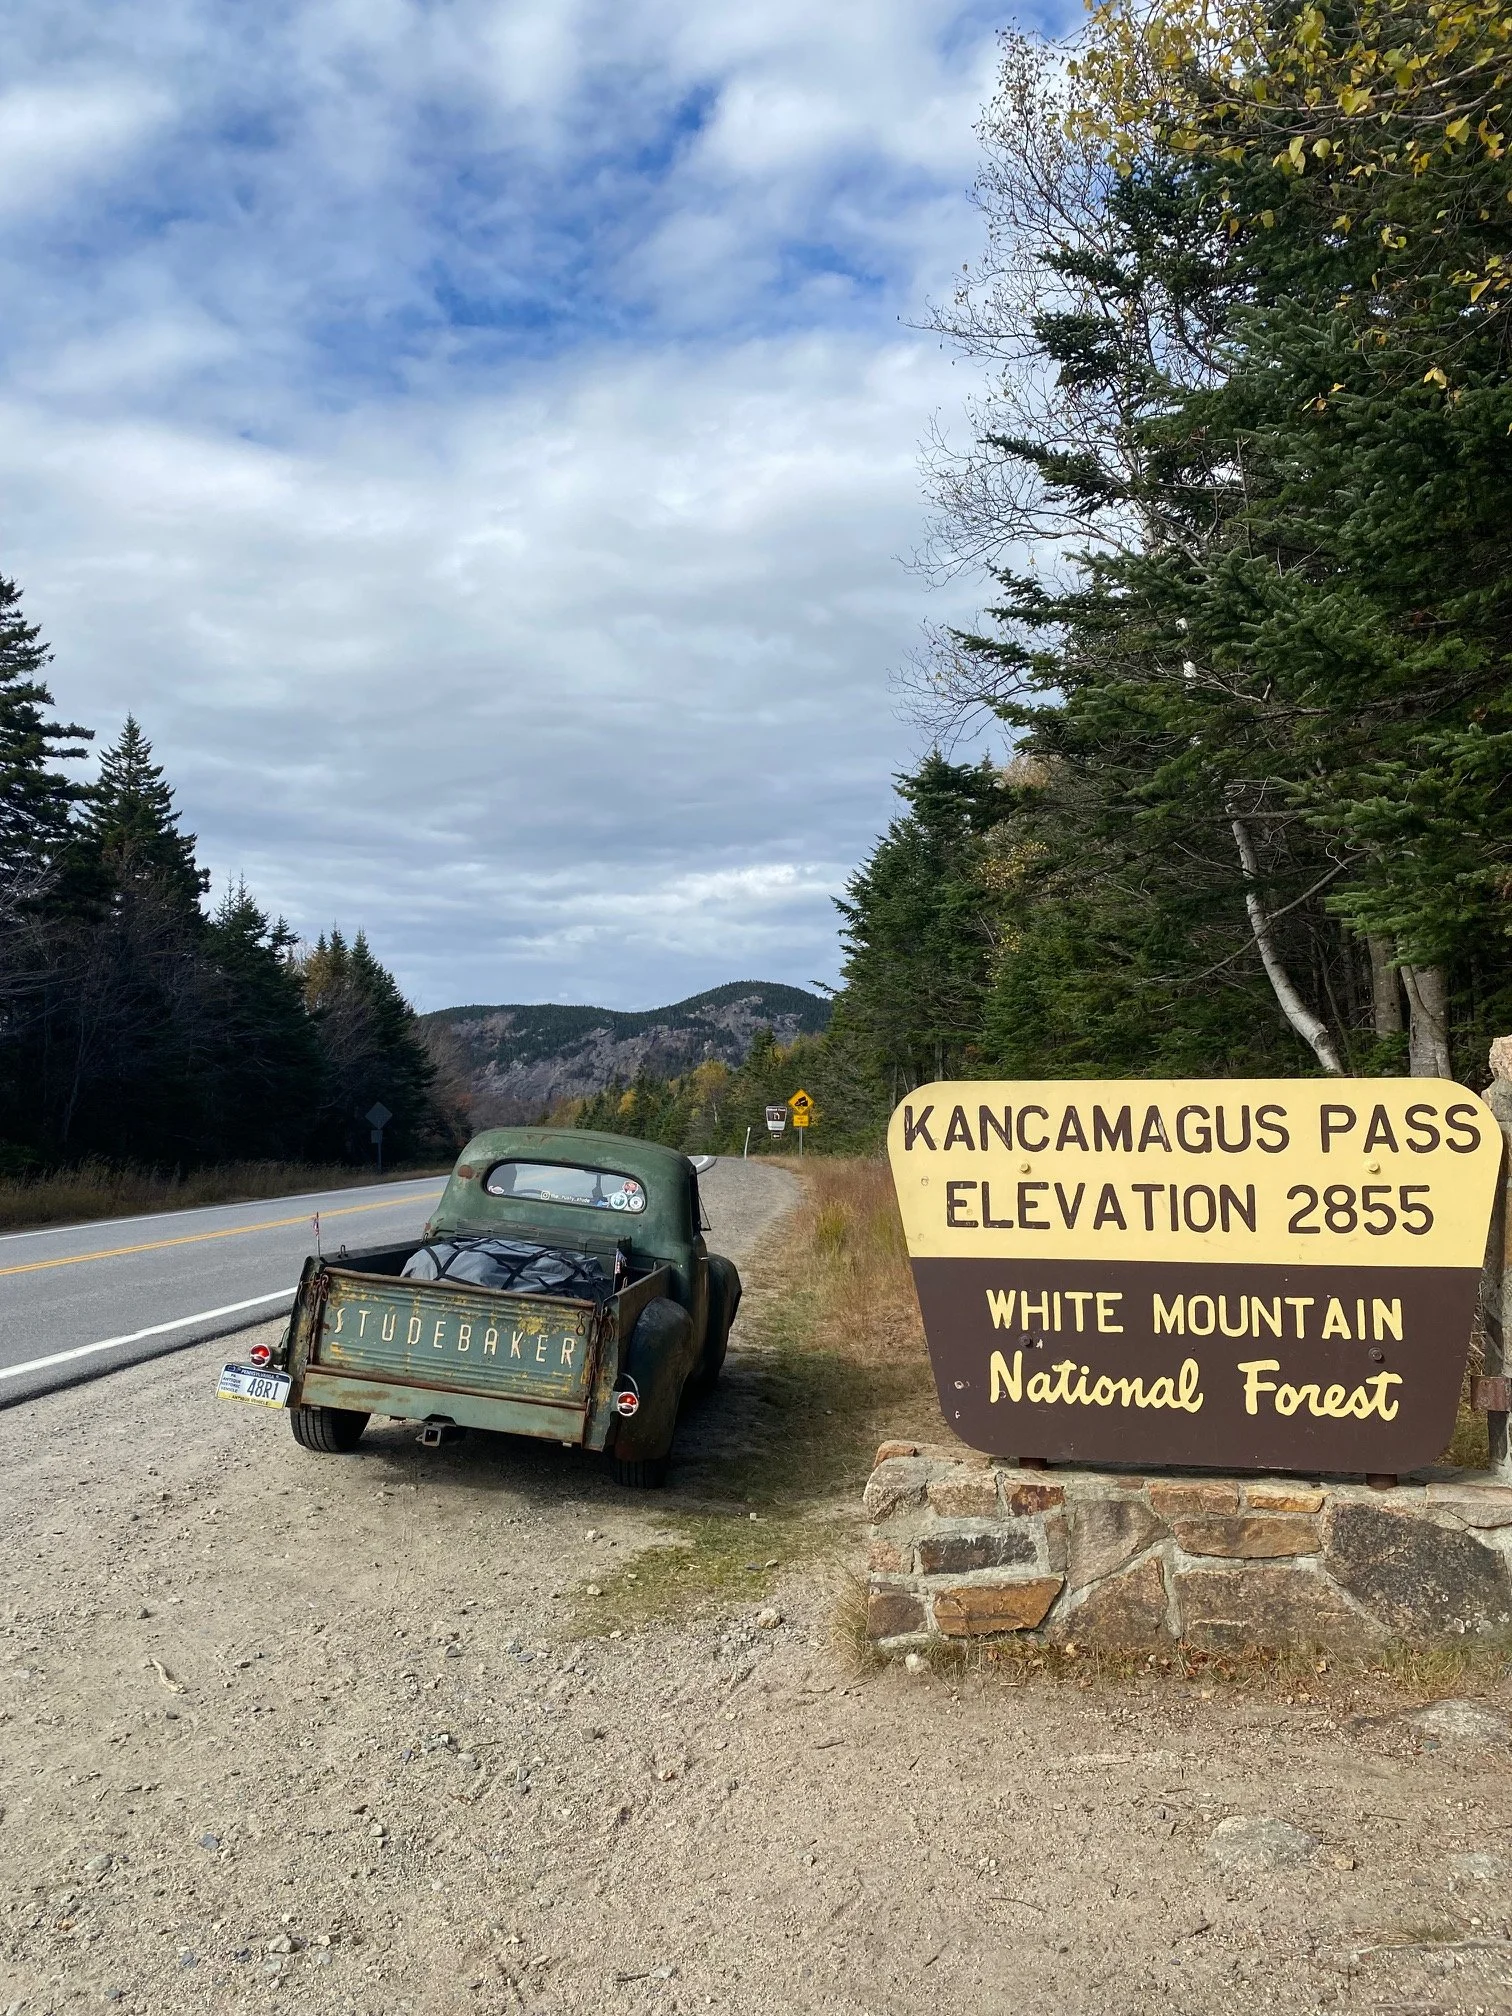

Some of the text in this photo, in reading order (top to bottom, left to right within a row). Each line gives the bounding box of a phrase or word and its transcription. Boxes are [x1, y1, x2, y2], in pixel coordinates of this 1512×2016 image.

[904, 1104, 1481, 1153] KANCAMAGUS PASS
[946, 1181, 1434, 1236] ELEVATION 2855
[334, 1307, 575, 1368] STUDEBAKER
[986, 1289, 1403, 1341] WHITE MOUNTAIN
[240, 1368, 275, 1379] PENNSYLVANIA
[247, 1378, 279, 1400] 48R1
[989, 1350, 1403, 1422] National Forest
